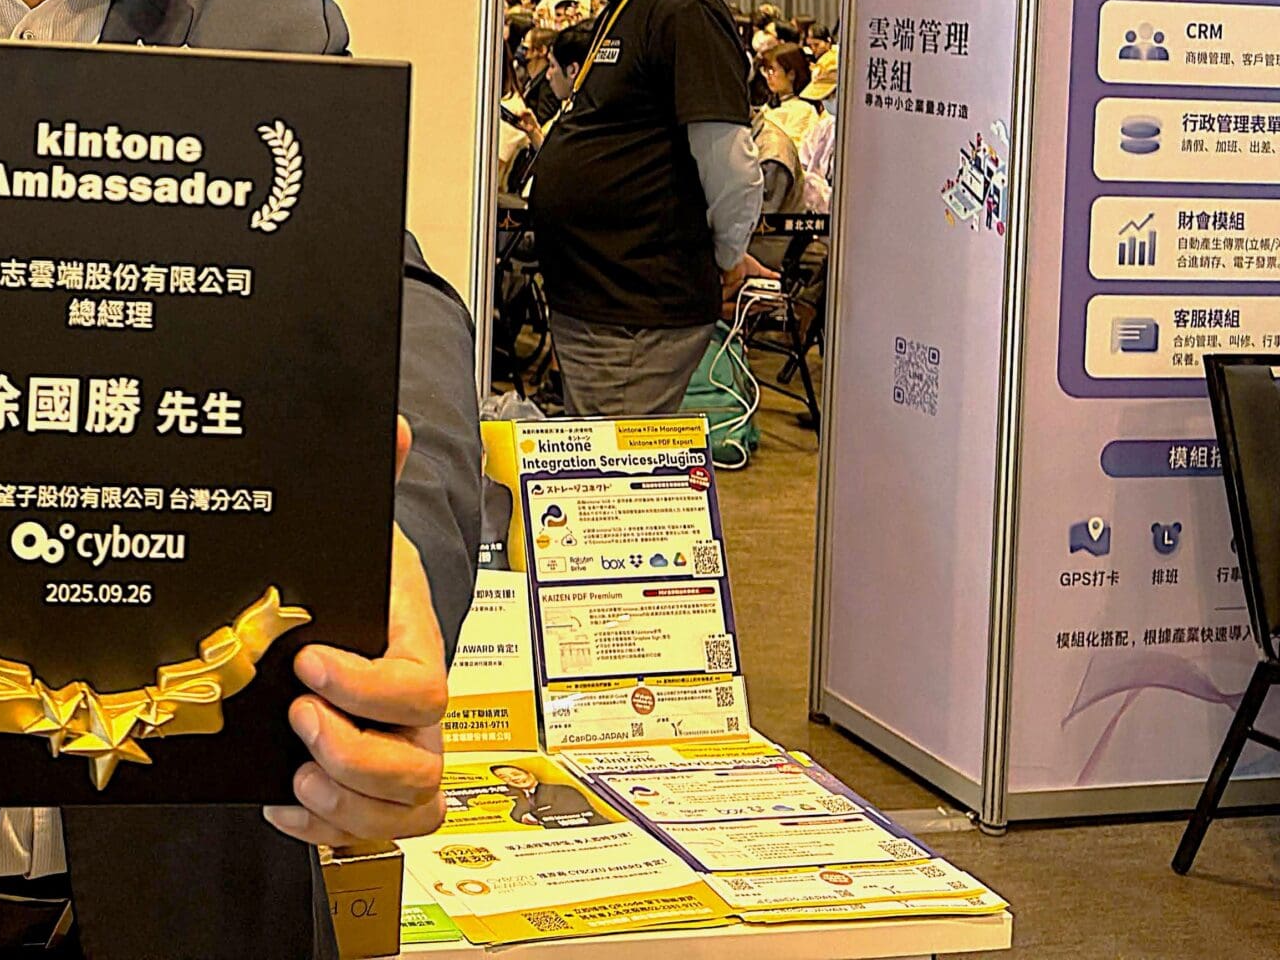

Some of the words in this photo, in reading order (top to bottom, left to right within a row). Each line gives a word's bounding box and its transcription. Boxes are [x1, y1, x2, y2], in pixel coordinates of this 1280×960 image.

[869, 17, 969, 56] 雲端管理
[1186, 23, 1223, 40] CRM
[866, 57, 912, 93] 模組
[1182, 113, 1280, 134] 行政管理表單
[37, 122, 202, 162] kintone
[1177, 211, 1245, 230] 財會模組
[68, 299, 153, 330] 總經理
[1173, 309, 1240, 329] 客服模組
[157, 390, 243, 437] 先生
[539, 440, 592, 453] kintone
[523, 456, 597, 471] Integration
[169, 487, 273, 513] 台灣分公司
[75, 525, 186, 567] cybozu
[601, 555, 626, 570] box
[1060, 571, 1120, 587] GPS打卡
[1152, 569, 1179, 585] 排班
[46, 584, 152, 605] 2025.09.26
[542, 593, 571, 603] KAIZEN
[573, 593, 588, 601] PDF
[591, 592, 623, 601] Premium
[462, 644, 494, 653] AWARD
